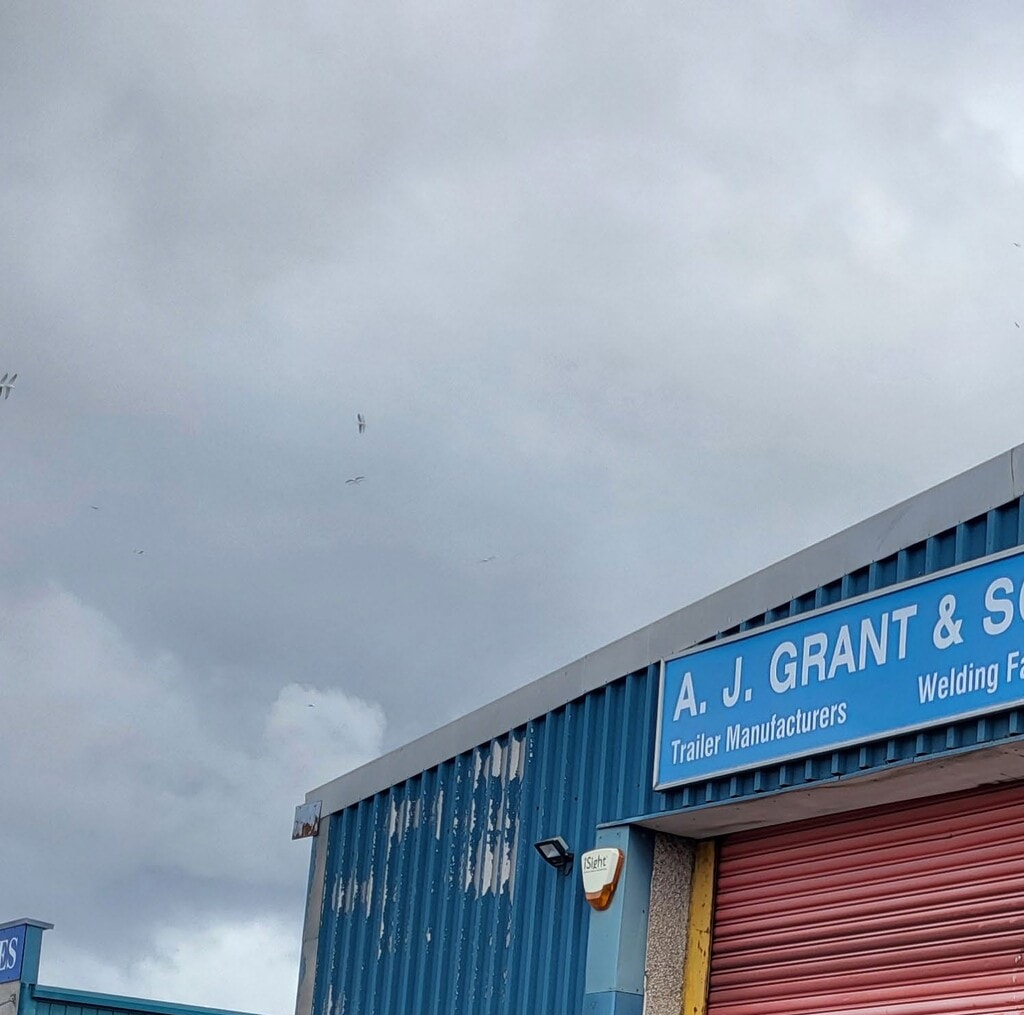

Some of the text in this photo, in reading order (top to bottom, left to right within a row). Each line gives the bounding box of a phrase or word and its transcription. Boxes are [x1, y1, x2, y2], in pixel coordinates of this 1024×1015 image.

[672, 671, 707, 722] A.
[722, 656, 752, 708] J.
[769, 604, 918, 694] GRANT
[932, 594, 963, 650] &
[918, 661, 999, 704] Welding
[671, 701, 847, 765] Trailer Manufacturers
